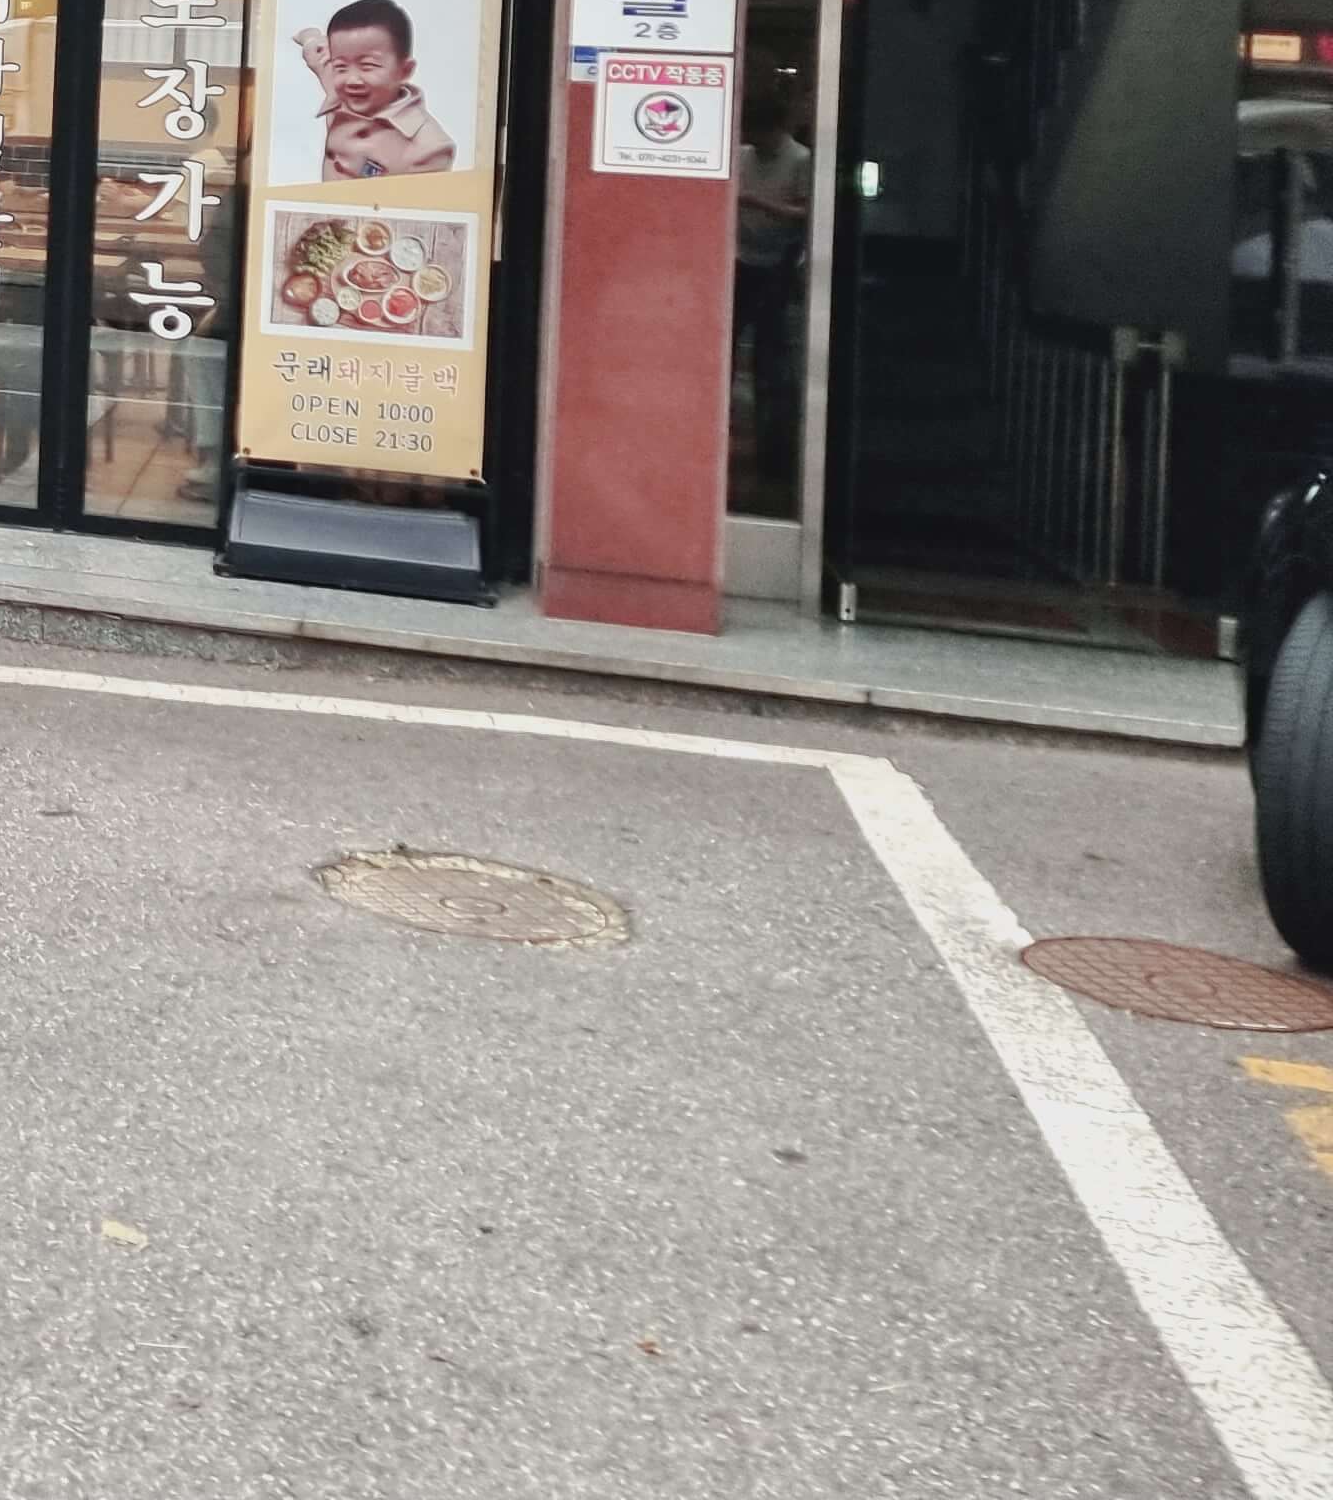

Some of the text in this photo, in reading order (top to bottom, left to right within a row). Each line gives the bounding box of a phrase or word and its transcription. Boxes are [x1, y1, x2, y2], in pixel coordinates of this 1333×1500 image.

[608, 63, 662, 81] CCTV
[665, 66, 723, 86] 작동중
[292, 394, 434, 424] OPEN 10:00
[291, 422, 433, 453] CLOSE 21:30
